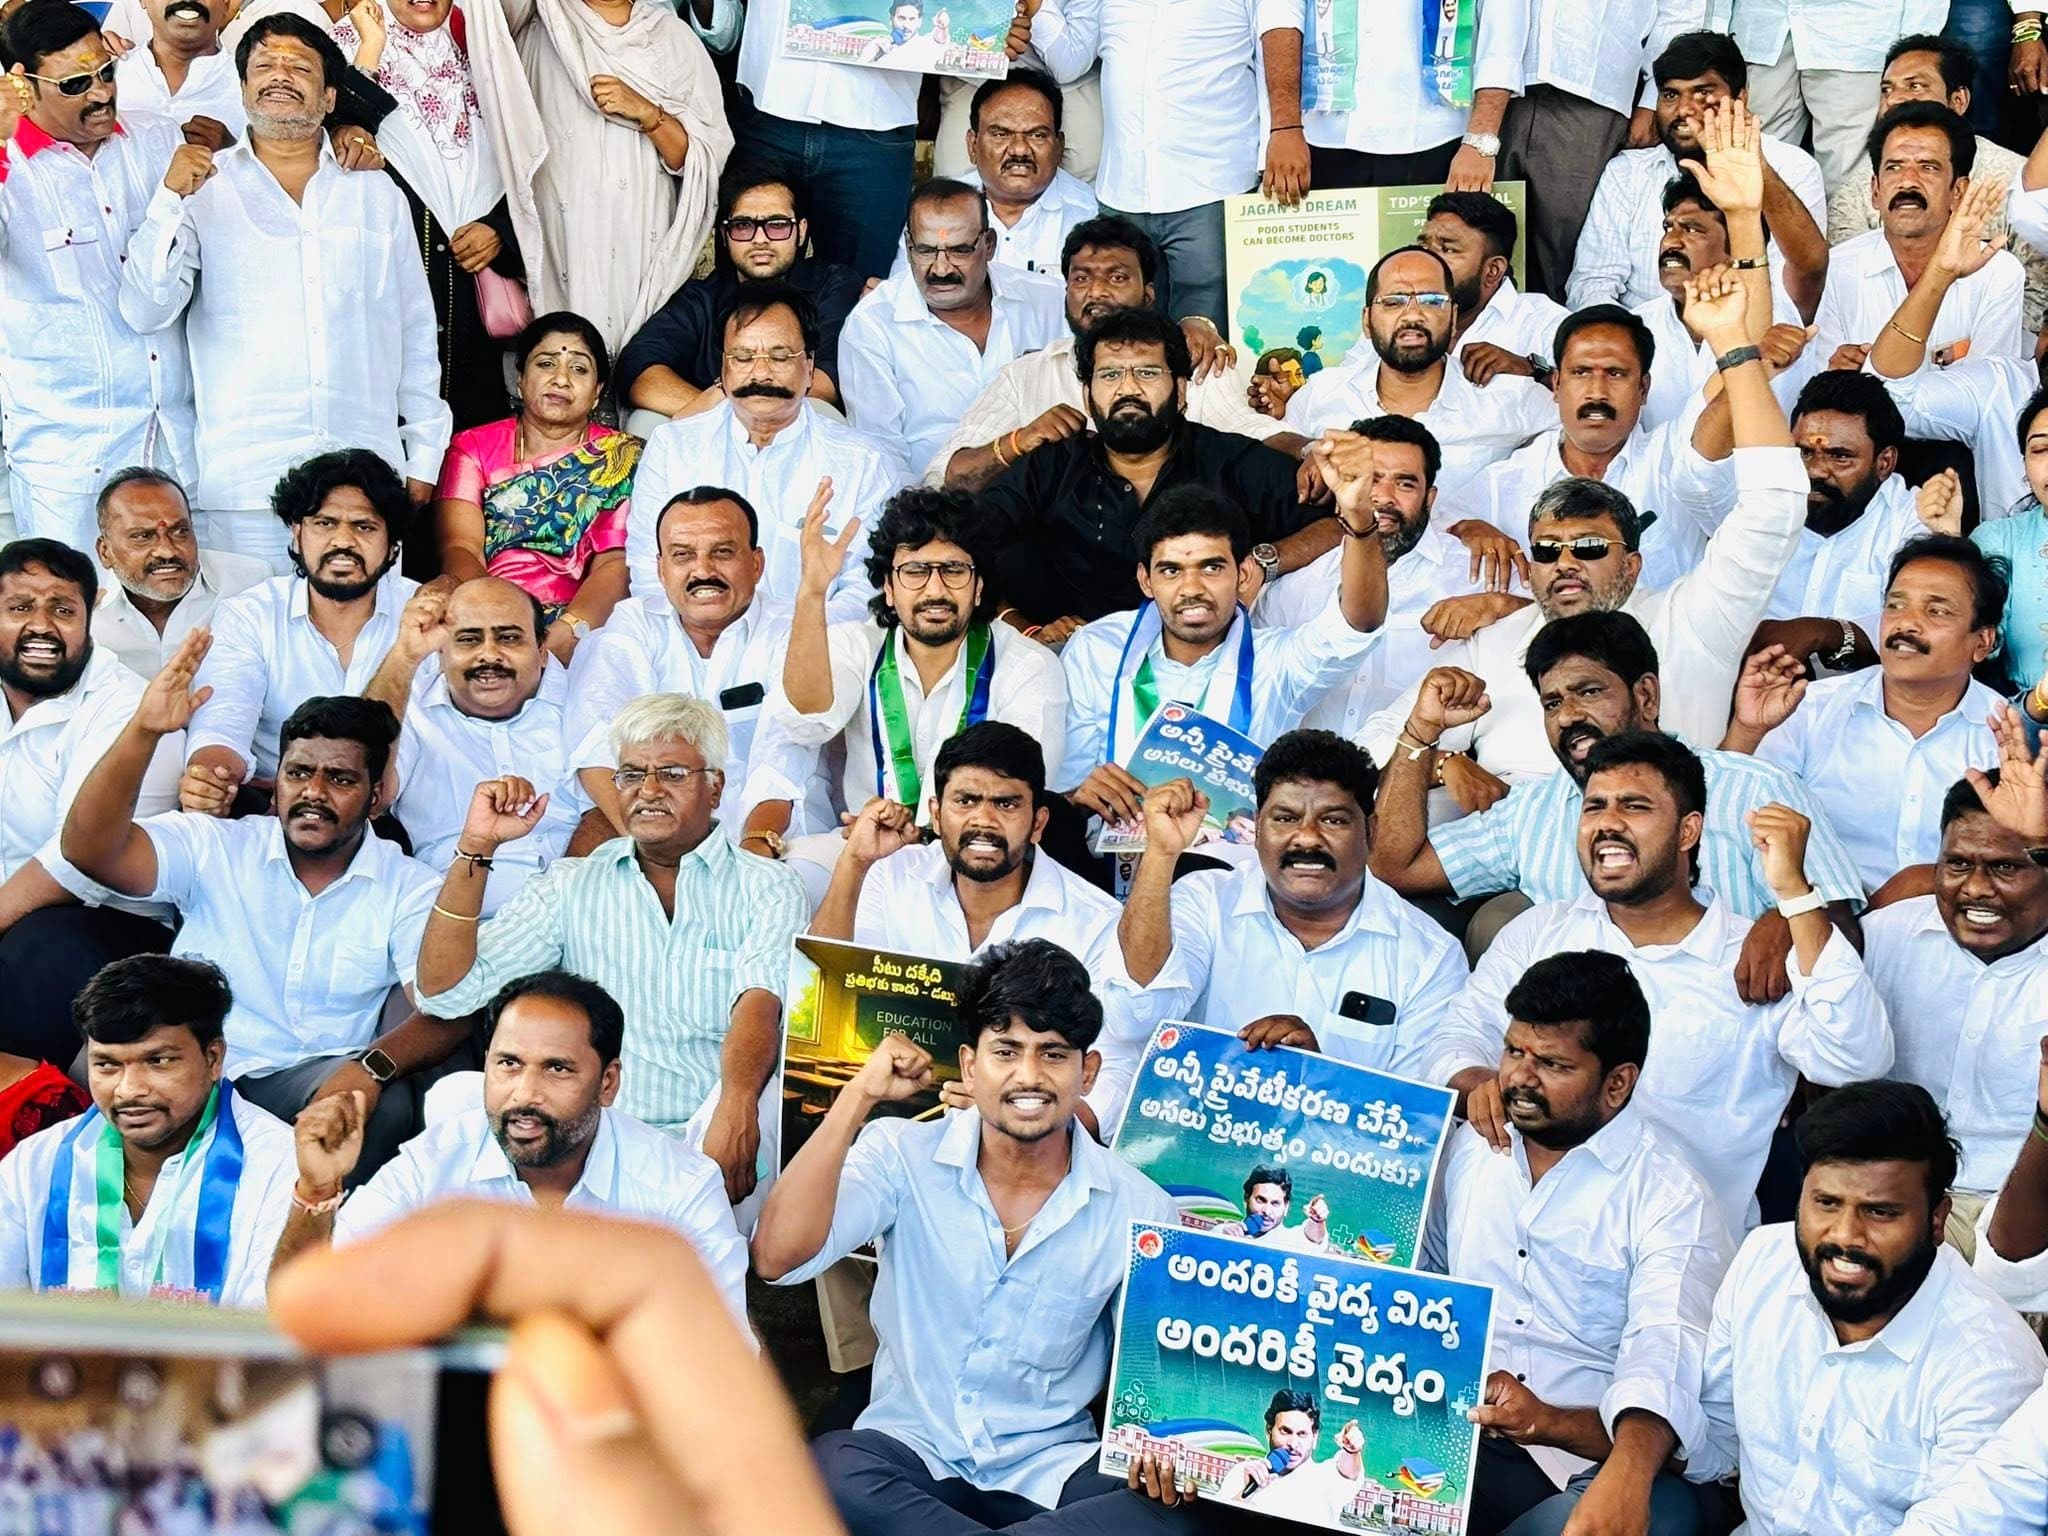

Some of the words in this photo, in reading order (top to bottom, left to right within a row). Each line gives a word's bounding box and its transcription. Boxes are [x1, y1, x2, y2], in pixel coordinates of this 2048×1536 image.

[1305, 199, 1357, 213] DREAM
[1389, 196, 1431, 208] TDP'S
[1243, 237, 1263, 246] CAN
[1266, 235, 1306, 245] BECOME
[1309, 232, 1355, 242] DOCTORS
[1258, 224, 1285, 234] POOR
[1288, 222, 1340, 233] STUDENTS
[1142, 748, 1205, 773] అసలు
[872, 954, 902, 977] సీటు
[844, 973, 889, 990] ప్రతిభకు
[891, 982, 919, 996] కాదు
[876, 1011, 953, 1032] EDUCATION
[912, 1032, 937, 1045] ALL
[1204, 1062, 1350, 1125] ప్రైవేటీకరణ
[1140, 1097, 1207, 1131] అసలు
[1208, 1113, 1306, 1163] ప్రభుత్వం
[1311, 1142, 1421, 1188] ఎందుకు?
[1168, 1254, 1299, 1304] అందరికీ
[1305, 1273, 1380, 1335] వైద్య
[1387, 1289, 1460, 1349] విద్య
[1156, 1317, 1316, 1378] అందరికీ
[1325, 1342, 1445, 1416] వైద్యం
